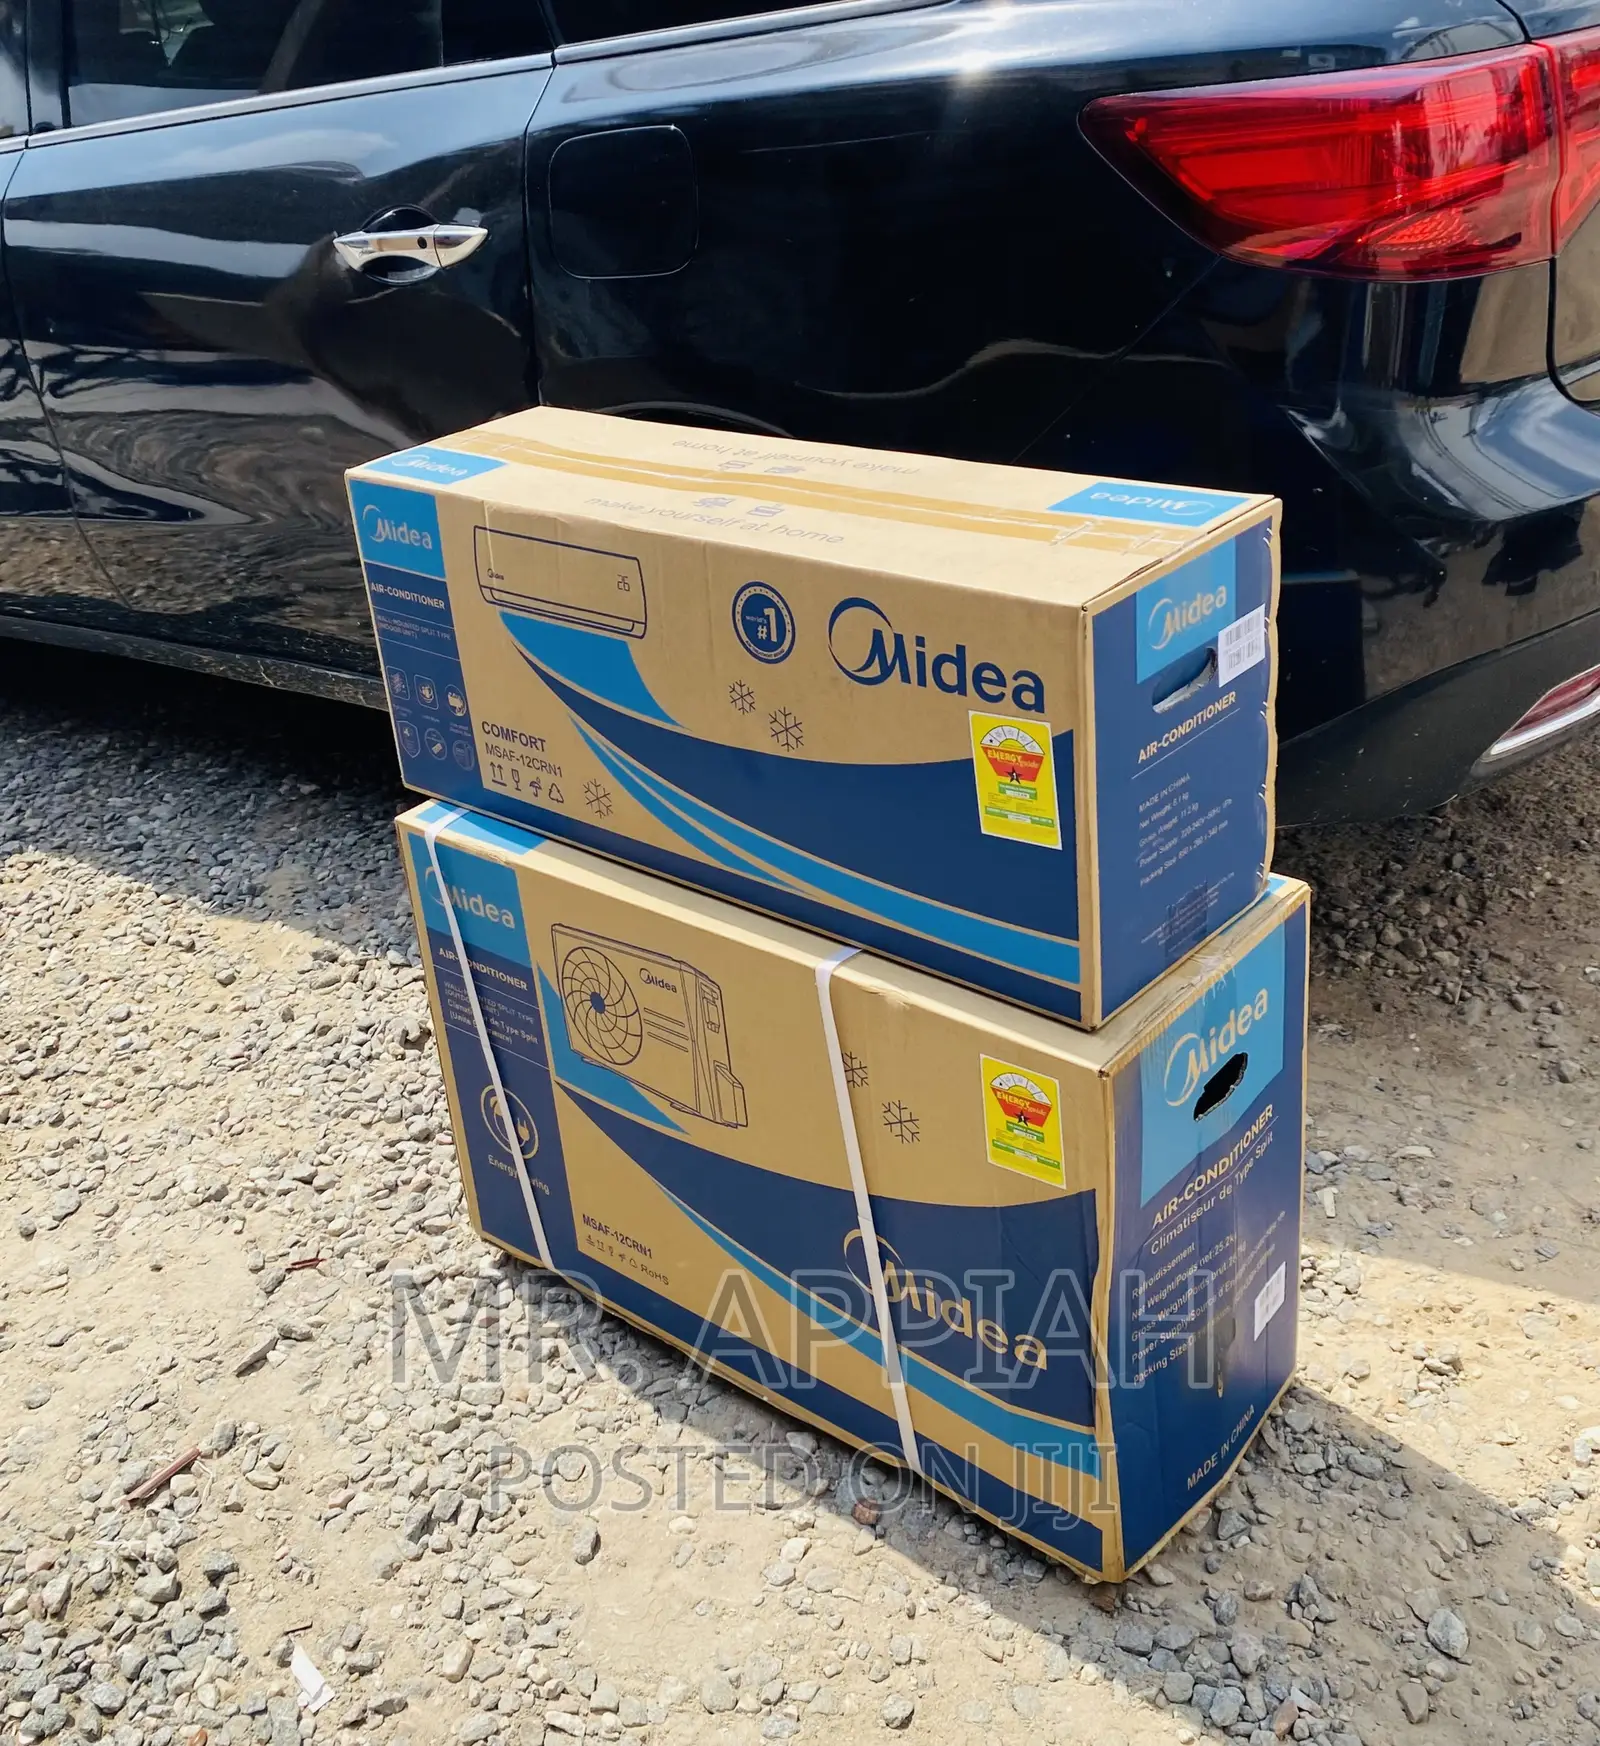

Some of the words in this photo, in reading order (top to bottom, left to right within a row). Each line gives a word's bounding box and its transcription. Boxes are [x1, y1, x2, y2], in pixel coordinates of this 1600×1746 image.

[392, 454, 468, 477] Midea
[1090, 492, 1215, 516] Midea
[362, 504, 432, 549] Midea
[371, 582, 445, 610] AIR-CONDITIONER
[1148, 585, 1227, 650] Midea
[828, 597, 1045, 714] Midea
[482, 721, 546, 752] COMFORT
[1138, 691, 1236, 764] AIR-CONDITIONER
[485, 742, 562, 778] MSAF-12CRN1
[439, 948, 528, 991] AIR-ONDITIONER
[639, 968, 677, 993] Midea
[1164, 988, 1268, 1107] Midea
[1152, 1103, 1273, 1229] AIR-CONDITIONER
[1151, 1194, 1216, 1255] Climatiseur
[1219, 1182, 1233, 1200] de
[1234, 1159, 1254, 1185] Type
[1255, 1130, 1273, 1159] Split
[582, 1213, 652, 1259] MSAF-12CRN1
[640, 1264, 669, 1286] RoHS
[1132, 1242, 1195, 1299] Refroidissement
[843, 1229, 1048, 1371] Midea
[1131, 1320, 1156, 1342] Gross
[1132, 1340, 1158, 1365] Power
[1133, 1357, 1168, 1386] Packing
[1187, 1452, 1218, 1490] MADE
[1220, 1439, 1230, 1459] IN
[1230, 1404, 1254, 1443] CHINA
